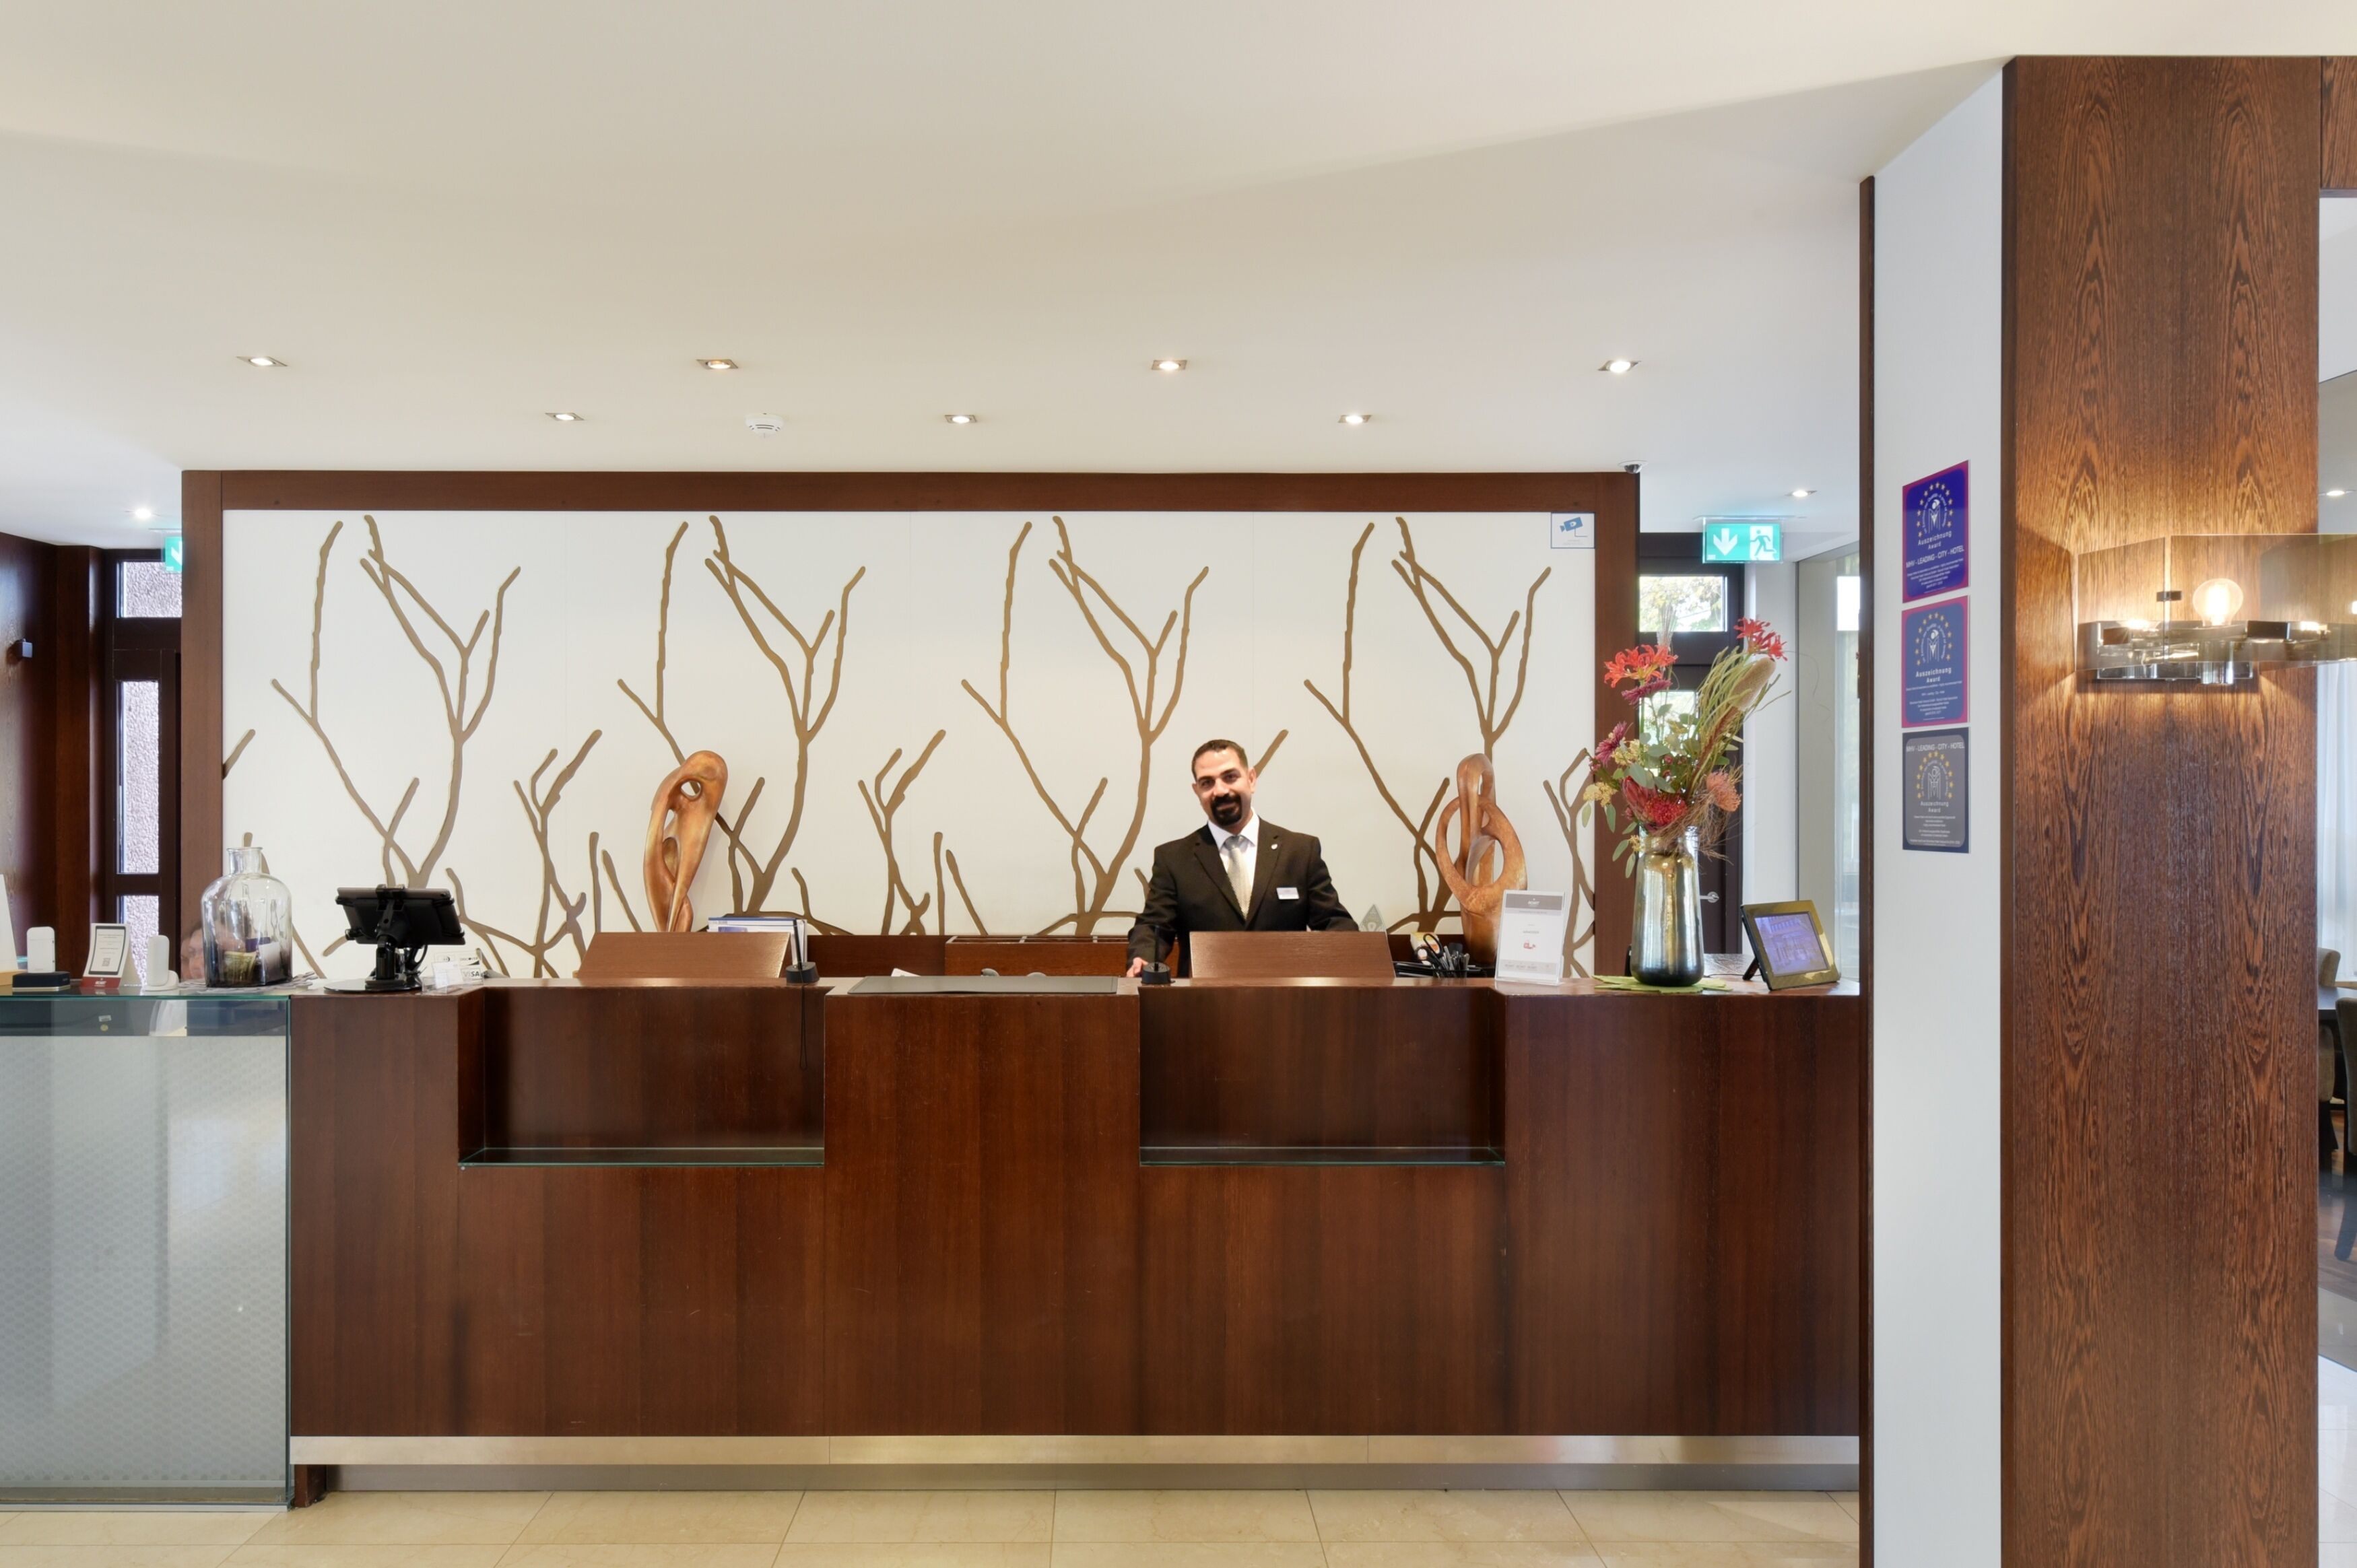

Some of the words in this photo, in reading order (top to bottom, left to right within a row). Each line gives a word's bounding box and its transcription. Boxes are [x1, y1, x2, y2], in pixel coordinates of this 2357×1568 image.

[1918, 531, 1952, 545] Auszeichnung
[1927, 541, 1941, 549] Award
[1917, 553, 1935, 565] LEADING
[1937, 550, 1948, 559] CITY
[1950, 545, 1964, 554] HOTEL
[1915, 667, 1952, 677] Auszeichnung
